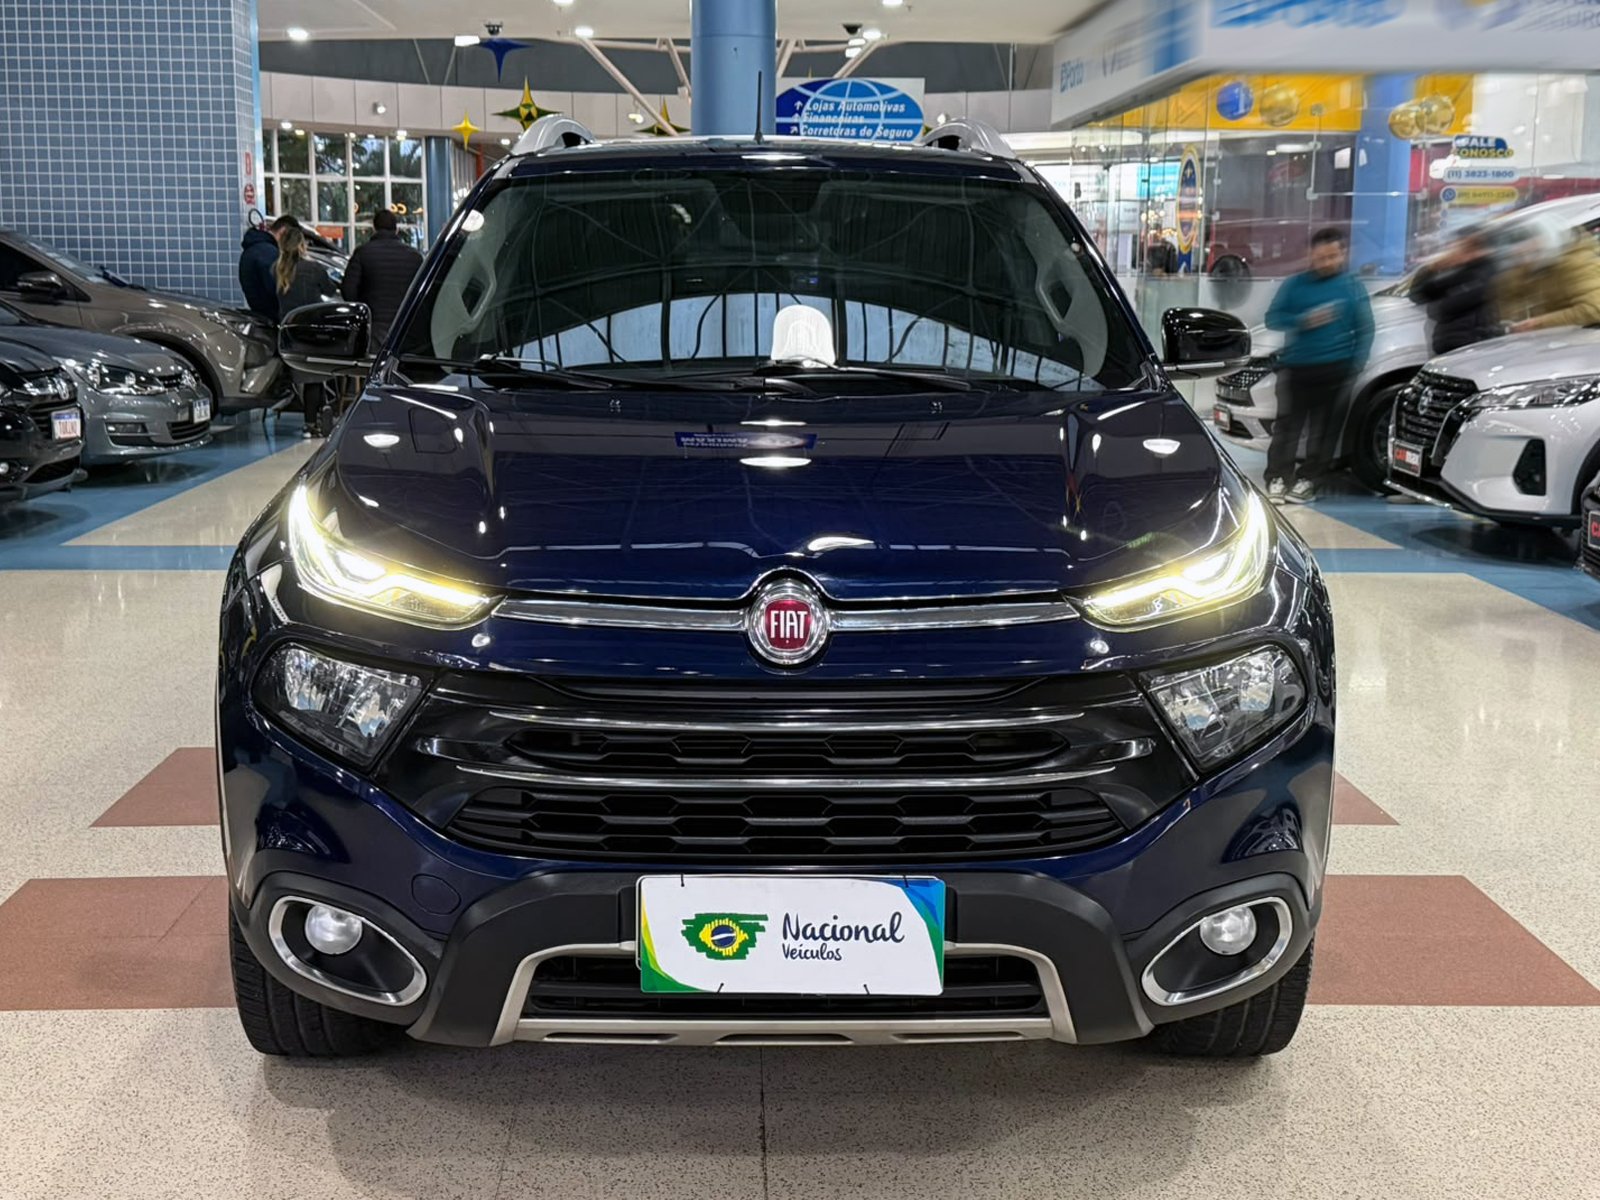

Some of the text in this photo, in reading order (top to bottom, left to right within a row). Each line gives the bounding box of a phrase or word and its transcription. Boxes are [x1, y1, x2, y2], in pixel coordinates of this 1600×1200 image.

[806, 100, 906, 112] Lojas Automotivas
[803, 113, 865, 124] Financeiras
[801, 125, 914, 139] Corretoras de Seguro
[1447, 170, 1462, 179] (11)
[770, 610, 808, 639] FIAT
[782, 911, 905, 943] Nacional
[782, 942, 842, 961] Veículos
